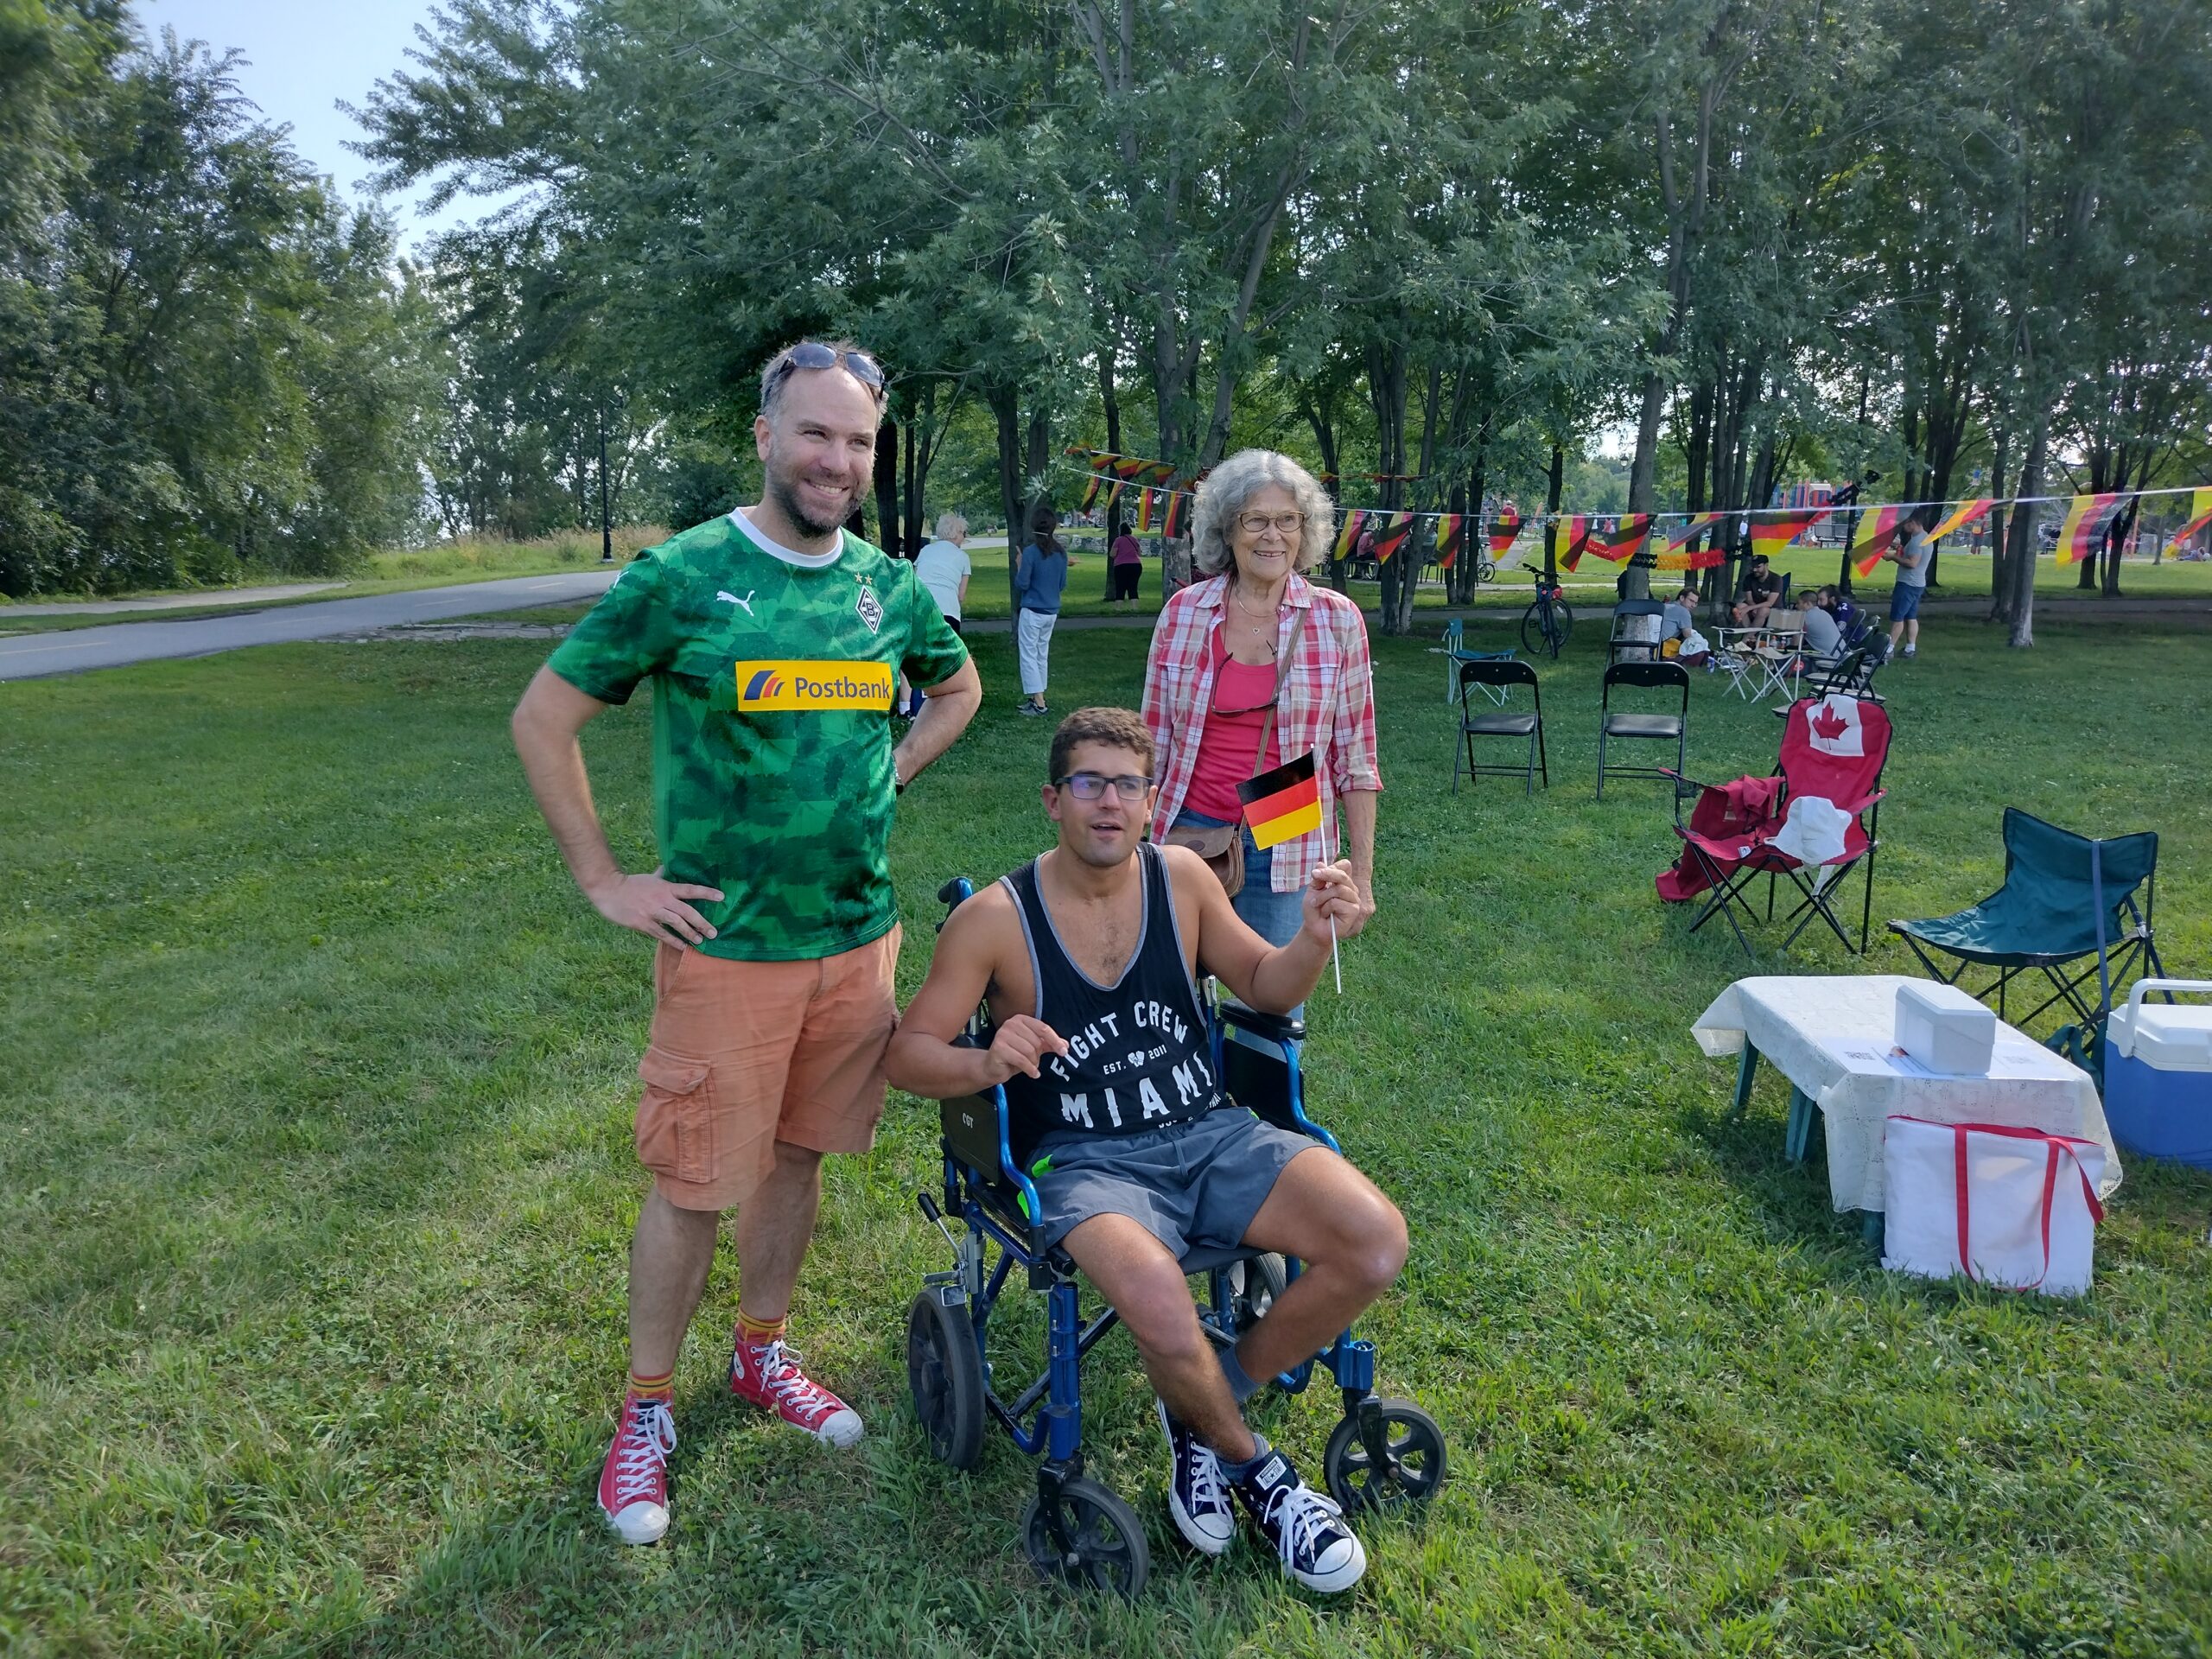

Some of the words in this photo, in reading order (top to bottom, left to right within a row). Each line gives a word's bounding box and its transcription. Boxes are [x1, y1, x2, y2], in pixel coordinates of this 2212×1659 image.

[795, 676, 890, 700] Postbank
[1050, 1012, 1119, 1082] FIGHT
[1134, 1001, 1188, 1044] CREW
[1103, 1060, 1127, 1075] EST.
[1147, 1044, 1167, 1059] 2011
[1059, 1051, 1213, 1128] MIAMI
